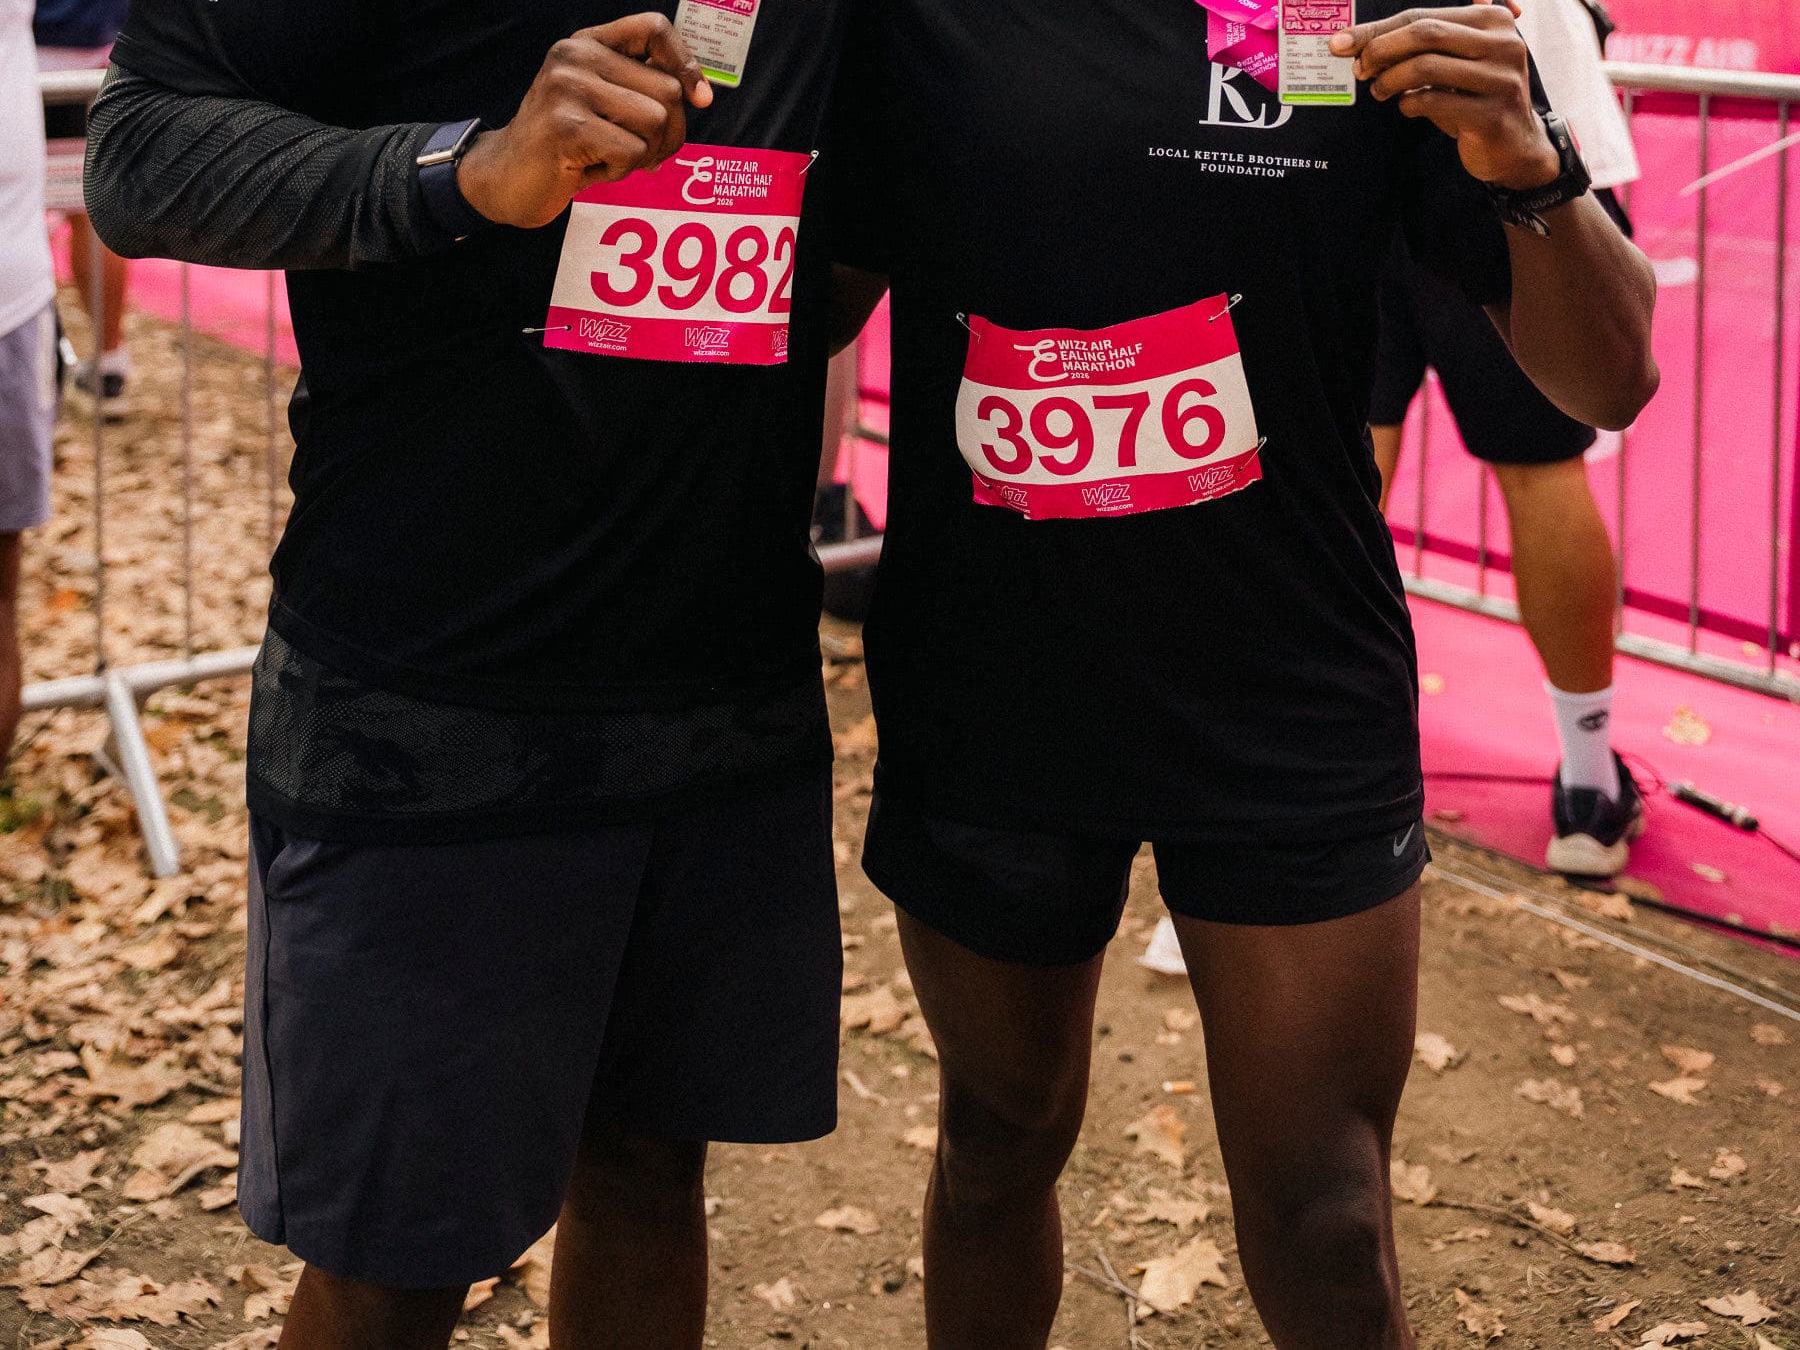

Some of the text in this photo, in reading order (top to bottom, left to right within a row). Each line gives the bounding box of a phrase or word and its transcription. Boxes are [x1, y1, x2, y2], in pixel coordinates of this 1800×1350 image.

[716, 159, 758, 172] WIZZ AIR
[1149, 147, 1329, 170] LOCAL KETTLE BROTHERS UK
[1200, 162, 1285, 178] FOUNDATION
[714, 171, 773, 186] EALING HALF
[713, 184, 767, 198] MARATHON
[716, 198, 734, 206] 2026
[590, 217, 796, 314] 3982
[588, 340, 627, 352] wizzair.com
[1057, 339, 1113, 351] WIZZ AIR
[1060, 343, 1143, 362] EALING HALF
[1062, 356, 1136, 372] MARATHON
[977, 378, 1226, 476] 3976
